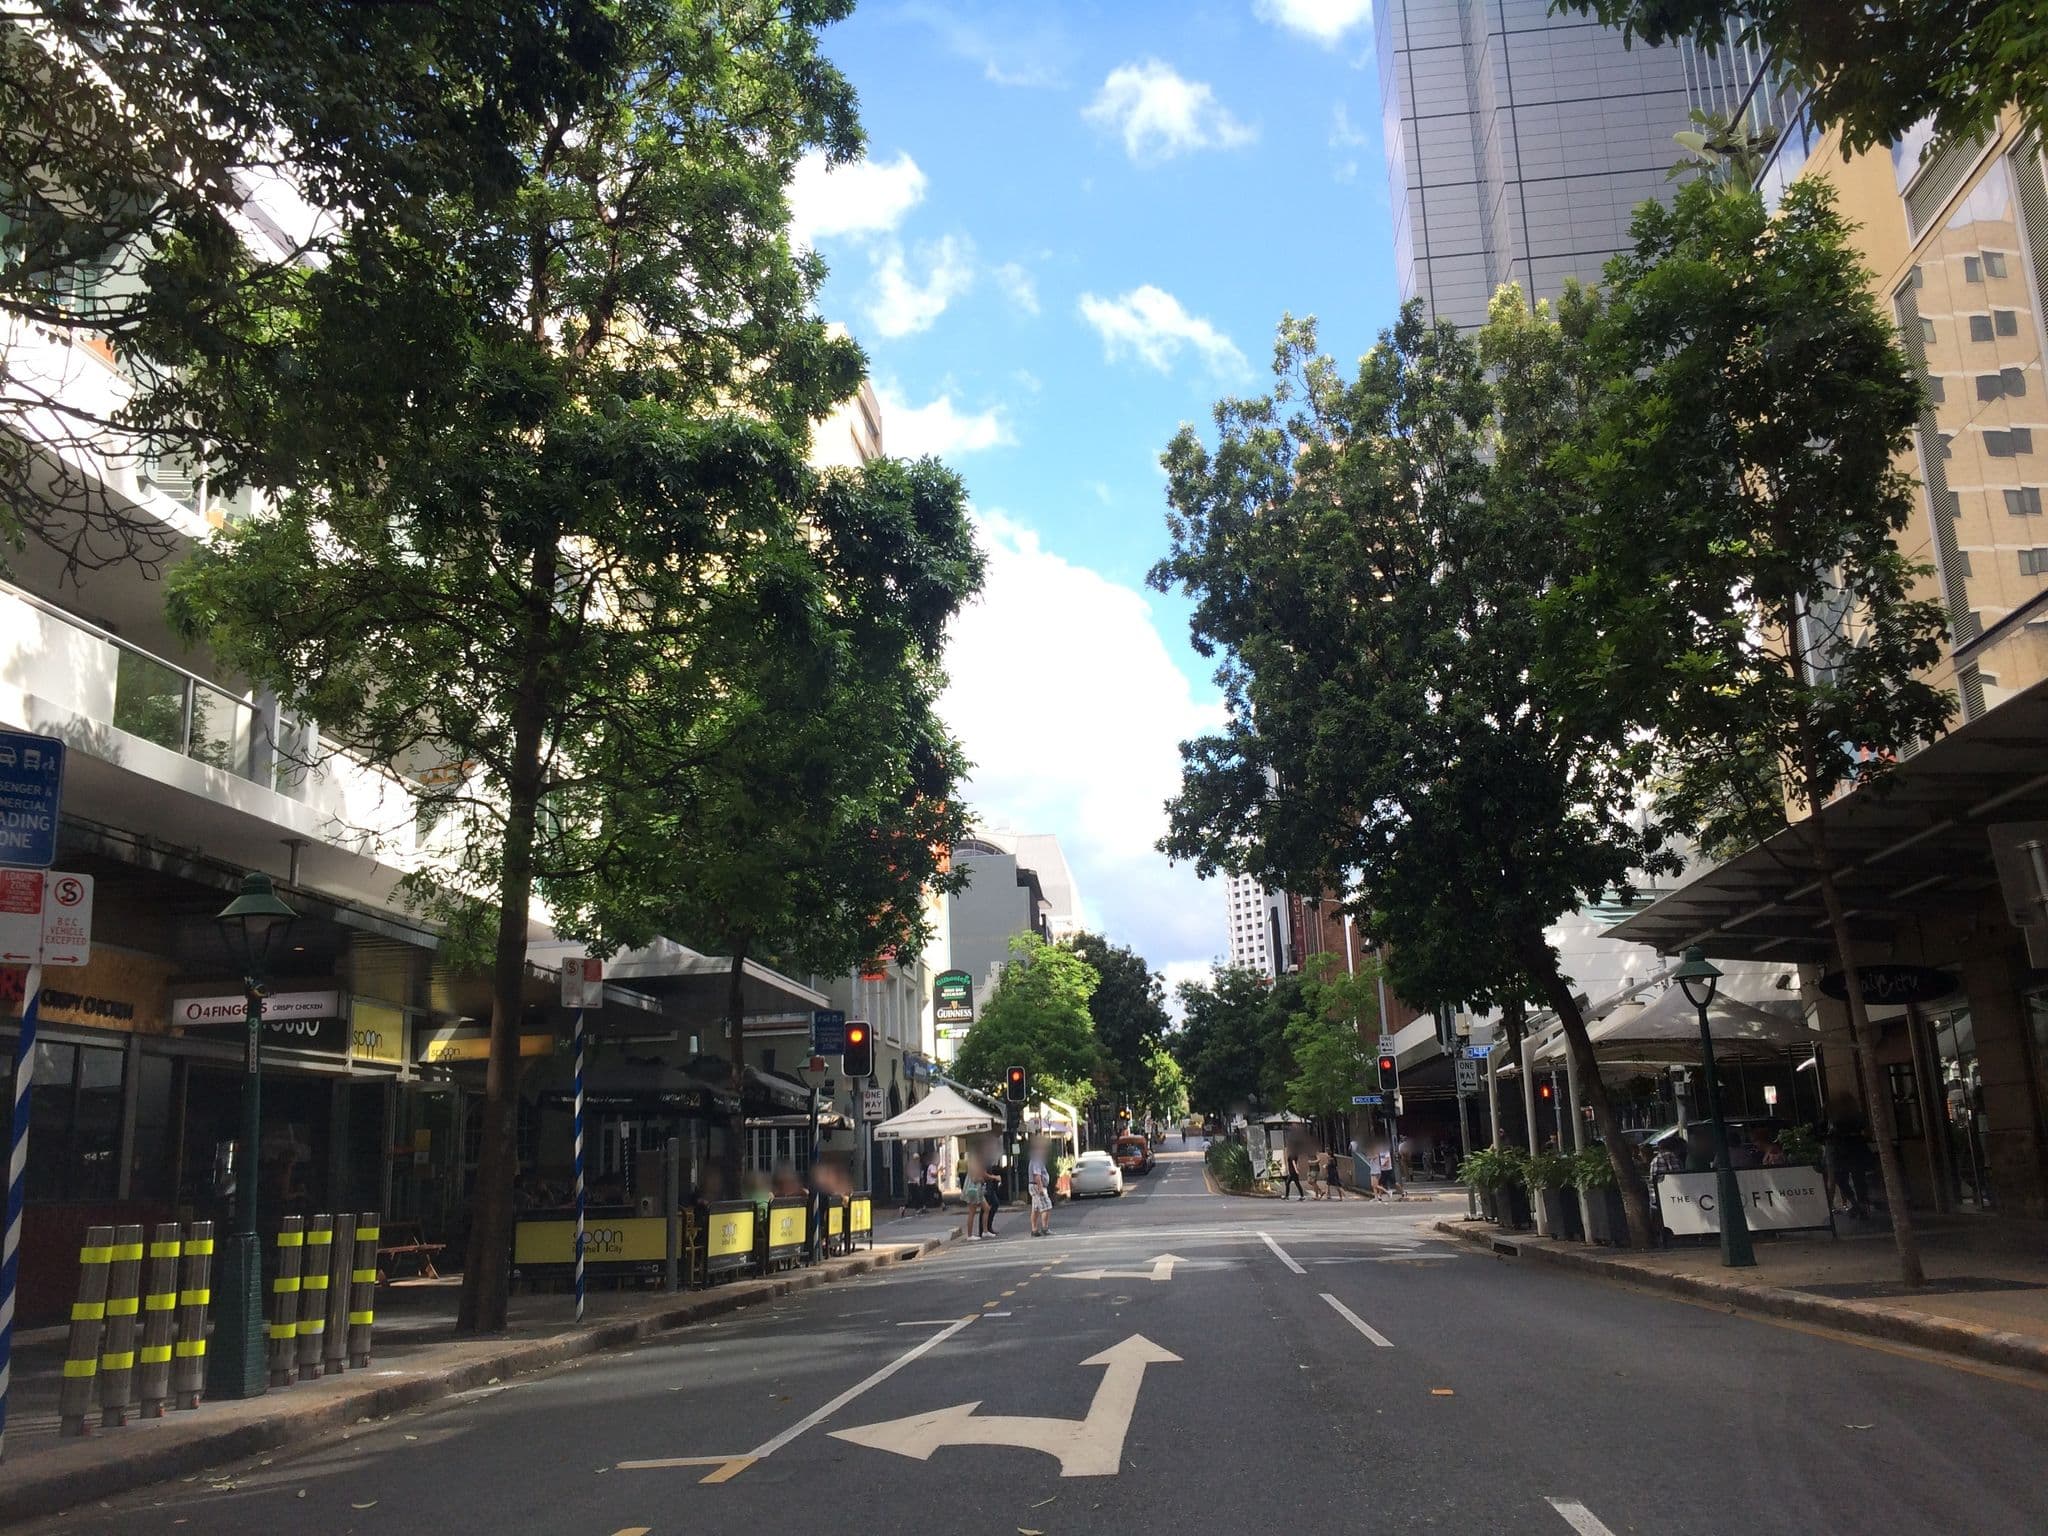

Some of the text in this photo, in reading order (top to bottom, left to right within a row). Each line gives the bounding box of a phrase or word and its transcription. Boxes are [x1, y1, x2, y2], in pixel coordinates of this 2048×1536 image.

[50, 926, 85, 936] VEHICLE
[44, 935, 87, 945] EXCEPTED
[202, 1002, 324, 1017] 4FINGES CRISPY CHICKEN
[936, 1008, 973, 1019] GUINNESS
[352, 1029, 382, 1059] spoon
[1459, 1062, 1475, 1070] ONE
[1459, 1071, 1476, 1080] WAY
[865, 1090, 882, 1099] ONE
[865, 1101, 882, 1109] WAY
[1670, 1195, 1691, 1204] THE
[1779, 1187, 1816, 1197] HOUSE
